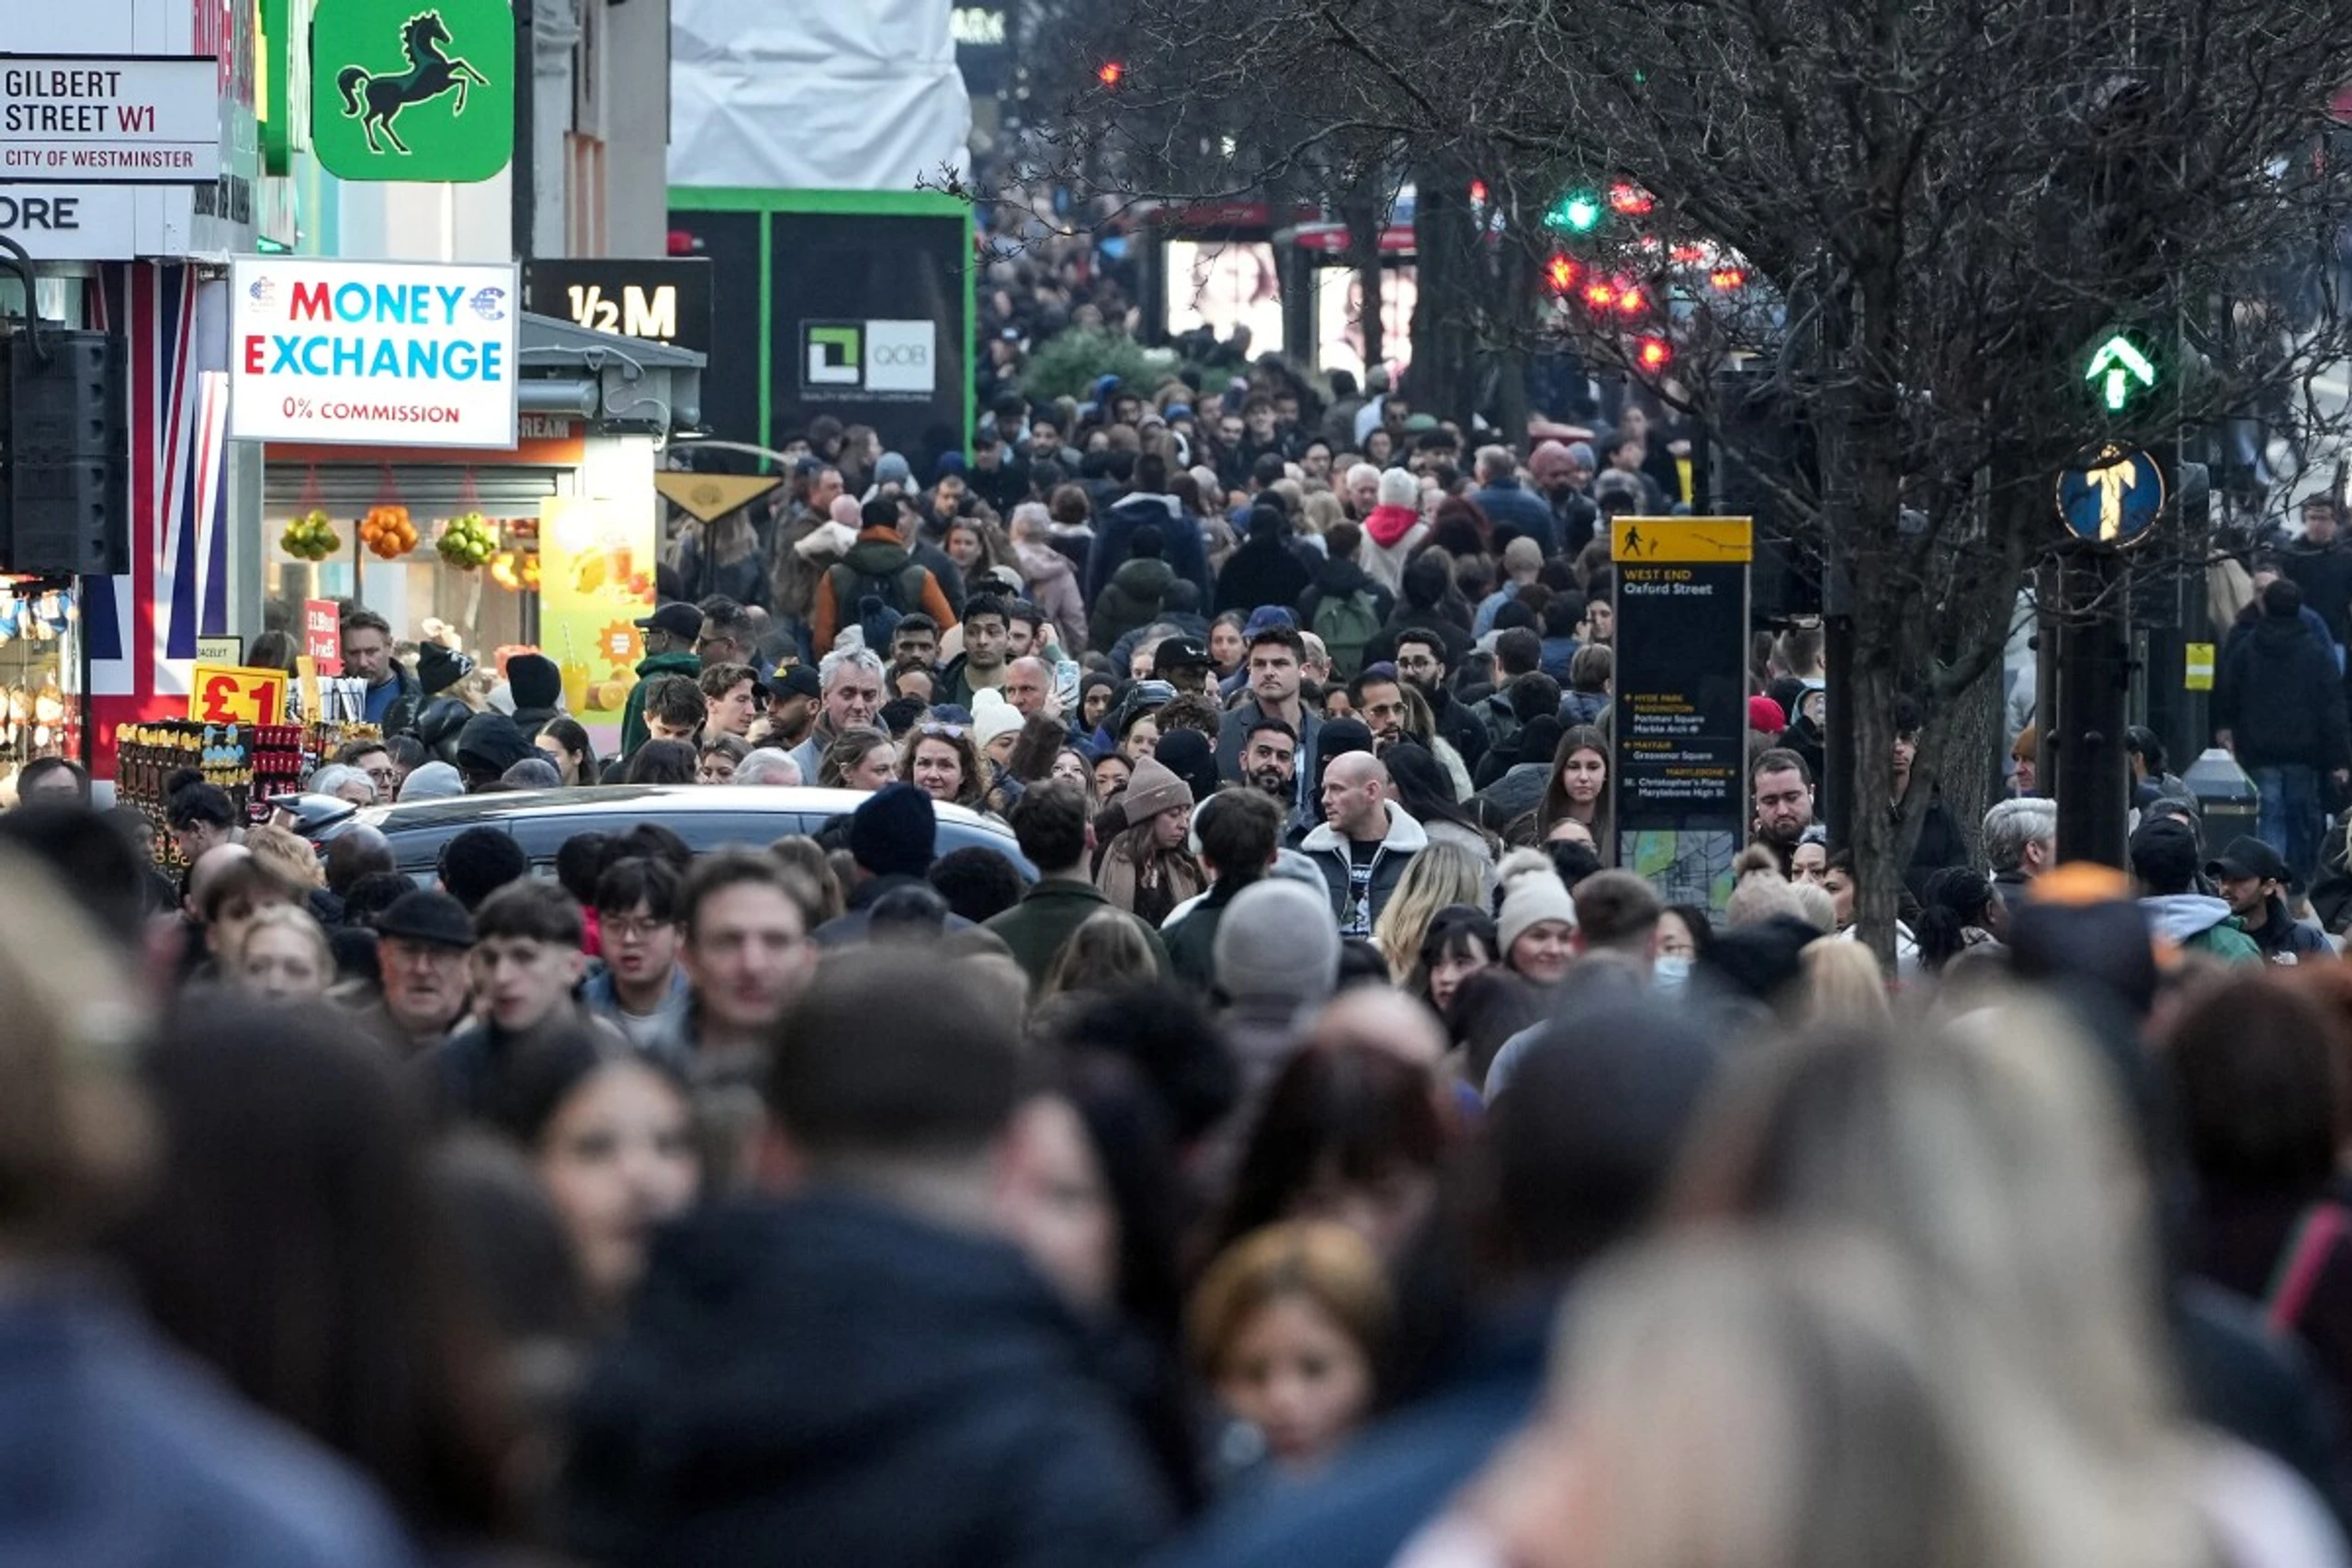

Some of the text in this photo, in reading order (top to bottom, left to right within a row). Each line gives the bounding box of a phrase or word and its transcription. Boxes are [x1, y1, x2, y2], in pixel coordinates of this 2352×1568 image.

[6, 70, 121, 97] GILBERT
[6, 104, 154, 132] STREET W1
[6, 151, 194, 167] CITY OF WESTMINSTER
[289, 281, 466, 325] MONEY
[245, 335, 502, 381] EXCHANGE
[283, 396, 459, 423] 0% COMMISSION
[1624, 569, 1692, 581] WEST END
[1624, 581, 1713, 594] Oxford Street
[202, 675, 276, 726] £1
[1674, 715, 1704, 724] Square
[1634, 725, 1688, 733] Marble Arch
[1681, 750, 1713, 761] Square
[1701, 778, 1725, 787] Place
[1638, 788, 1690, 798] Marylebone
[1693, 788, 1714, 798] High
